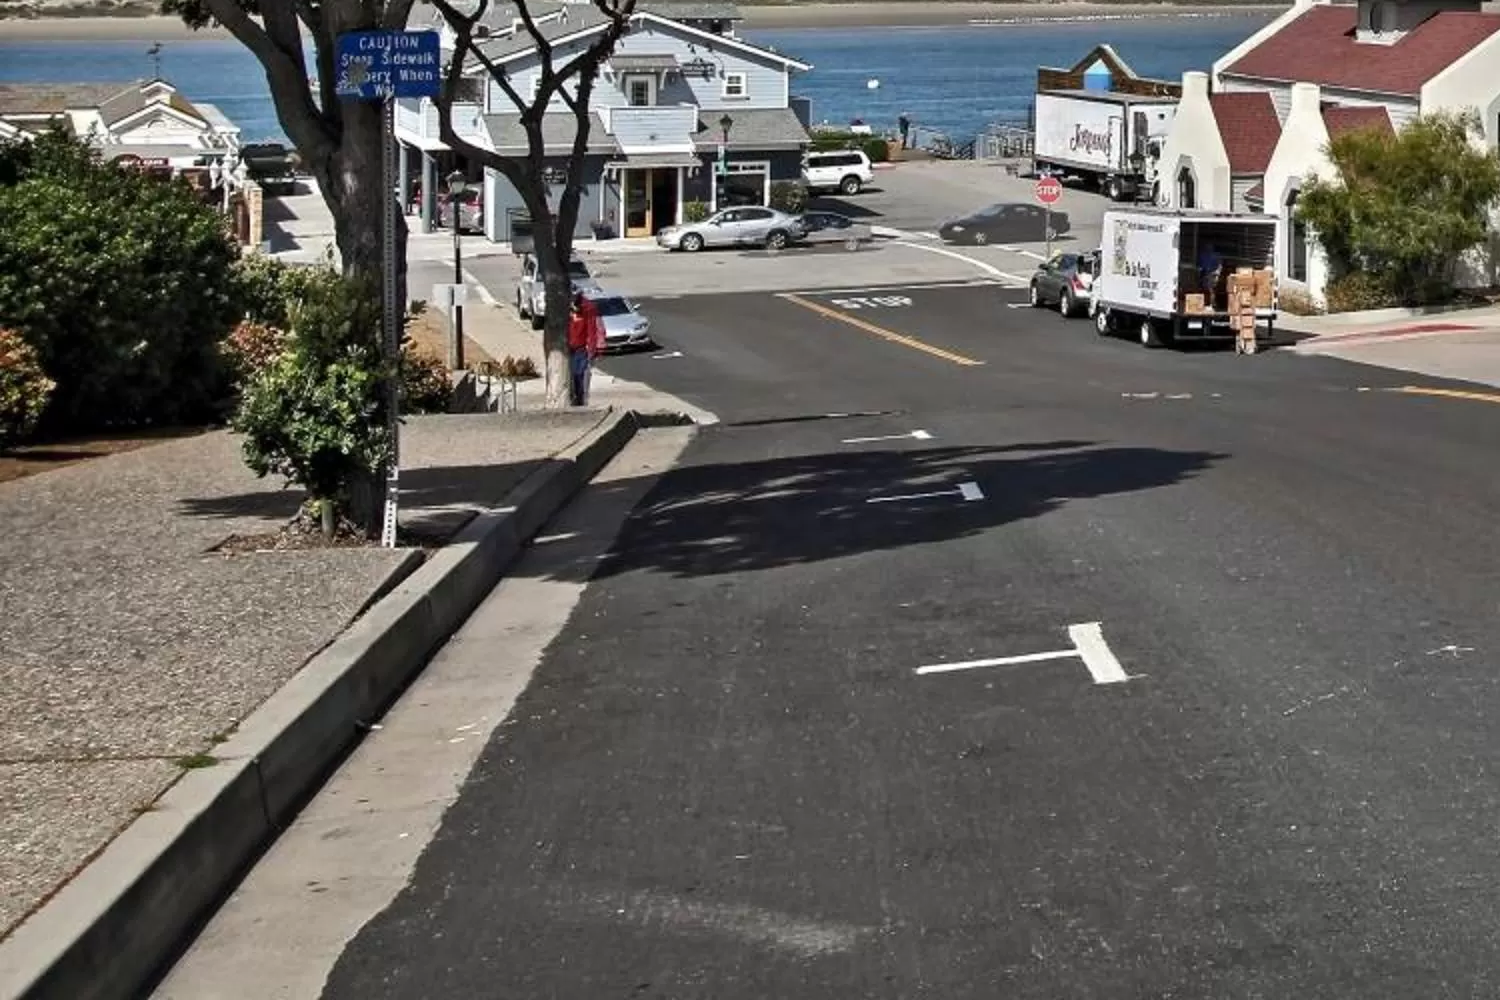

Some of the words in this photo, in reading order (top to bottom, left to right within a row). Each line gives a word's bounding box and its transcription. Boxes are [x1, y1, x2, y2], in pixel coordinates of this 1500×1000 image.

[359, 36, 419, 50] CAUTION
[381, 52, 436, 66] Sidewalk
[399, 69, 434, 81] When
[1037, 185, 1060, 196] STOP
[831, 296, 913, 309] STOP
